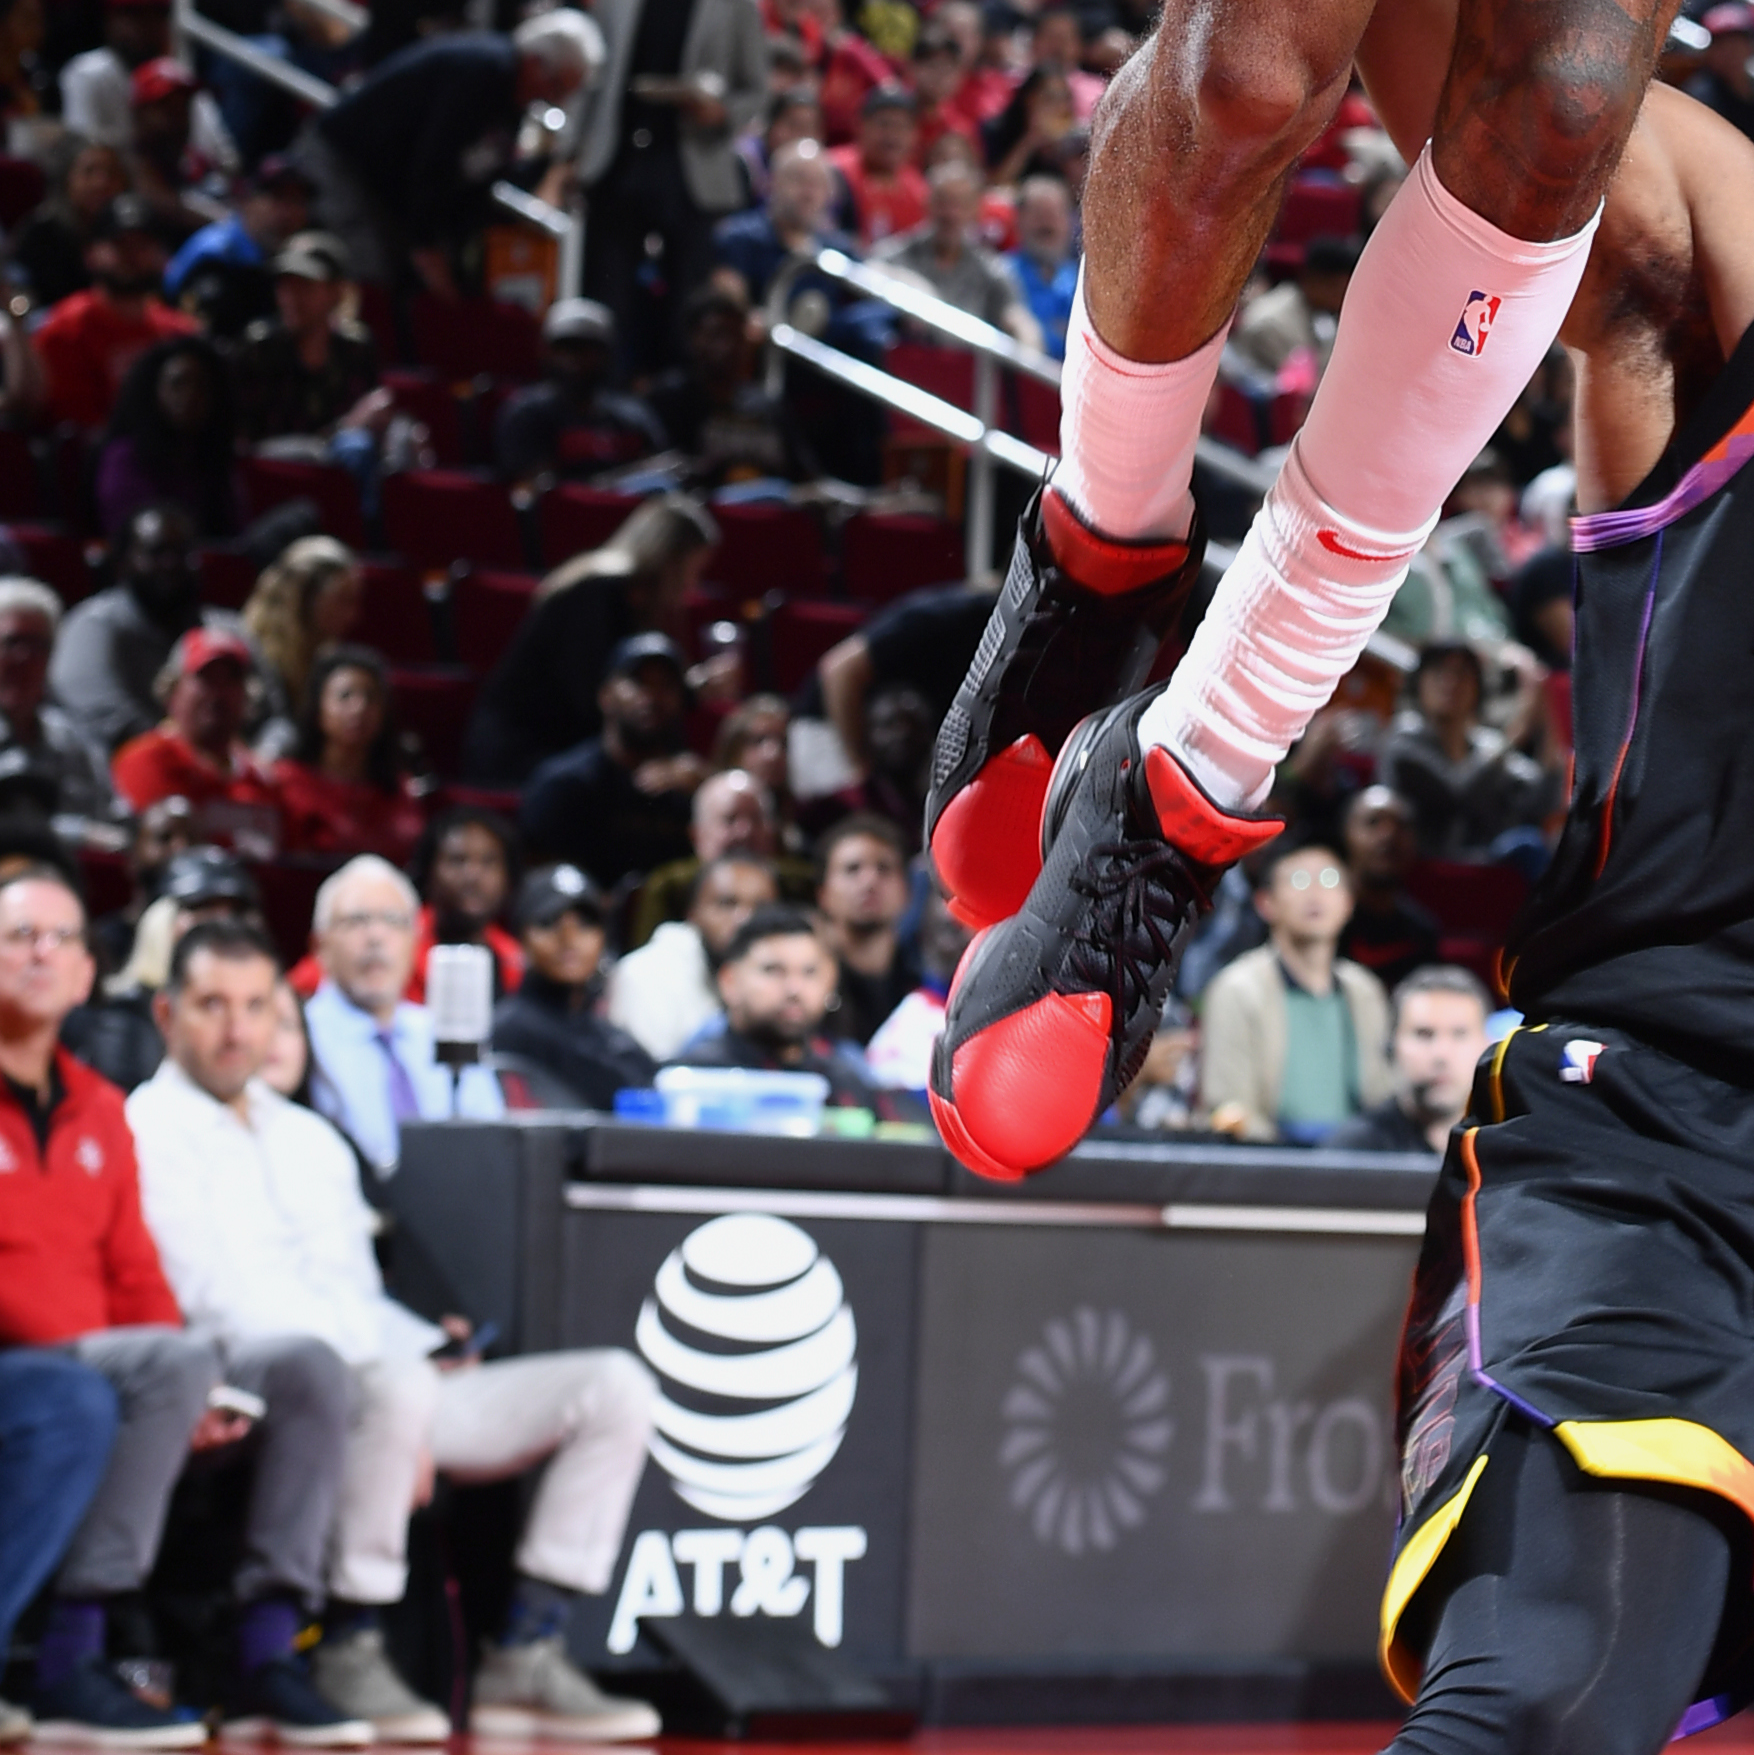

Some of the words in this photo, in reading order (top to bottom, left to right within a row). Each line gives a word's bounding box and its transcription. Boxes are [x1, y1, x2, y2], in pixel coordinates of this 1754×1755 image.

[1453, 335, 1472, 352] NBA
[1192, 1351, 1399, 1513] Fro
[607, 1526, 868, 1655] AT&T
